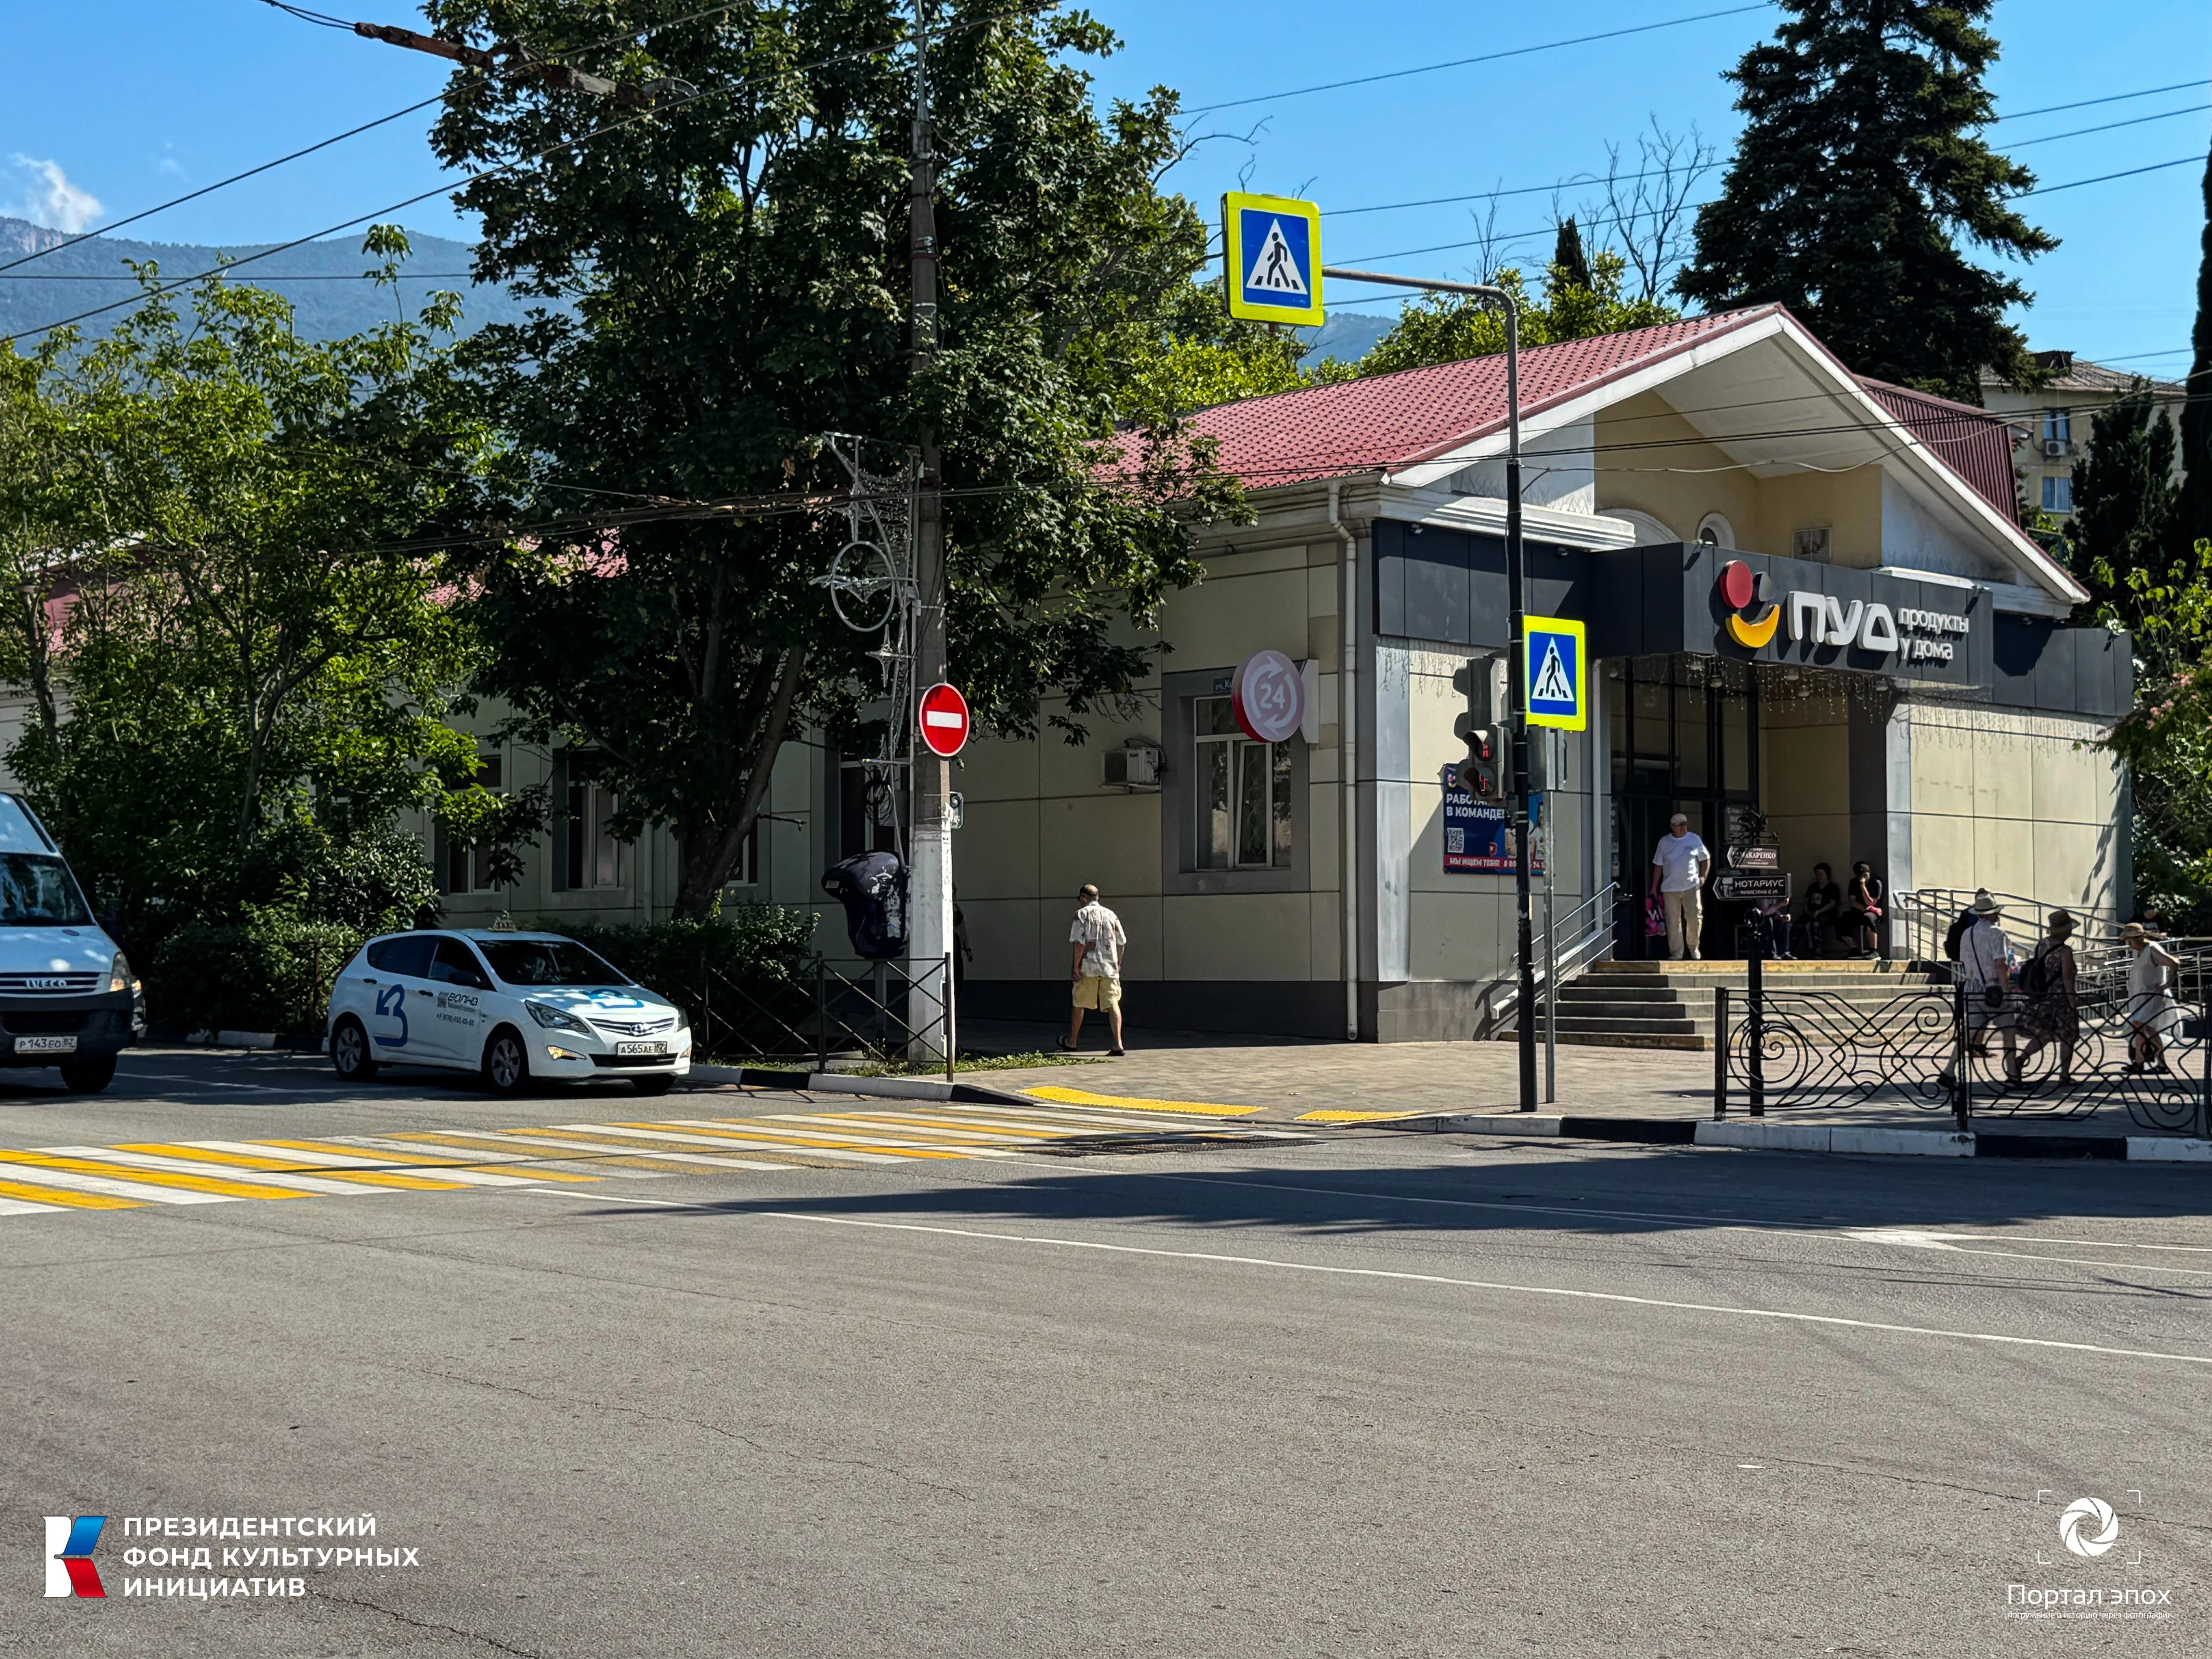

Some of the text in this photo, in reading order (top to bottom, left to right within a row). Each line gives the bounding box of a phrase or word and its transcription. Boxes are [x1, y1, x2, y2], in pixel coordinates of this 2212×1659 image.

[1788, 590, 1898, 652] ПУД
[1898, 608, 1969, 634] продукты
[1912, 639, 1953, 660] дома
[1260, 683, 1286, 710] 24
[1446, 806, 1505, 820] В КОМАНДЕ!
[1734, 879, 1784, 888] НОТАРИУС
[25, 979, 67, 988] IVECO
